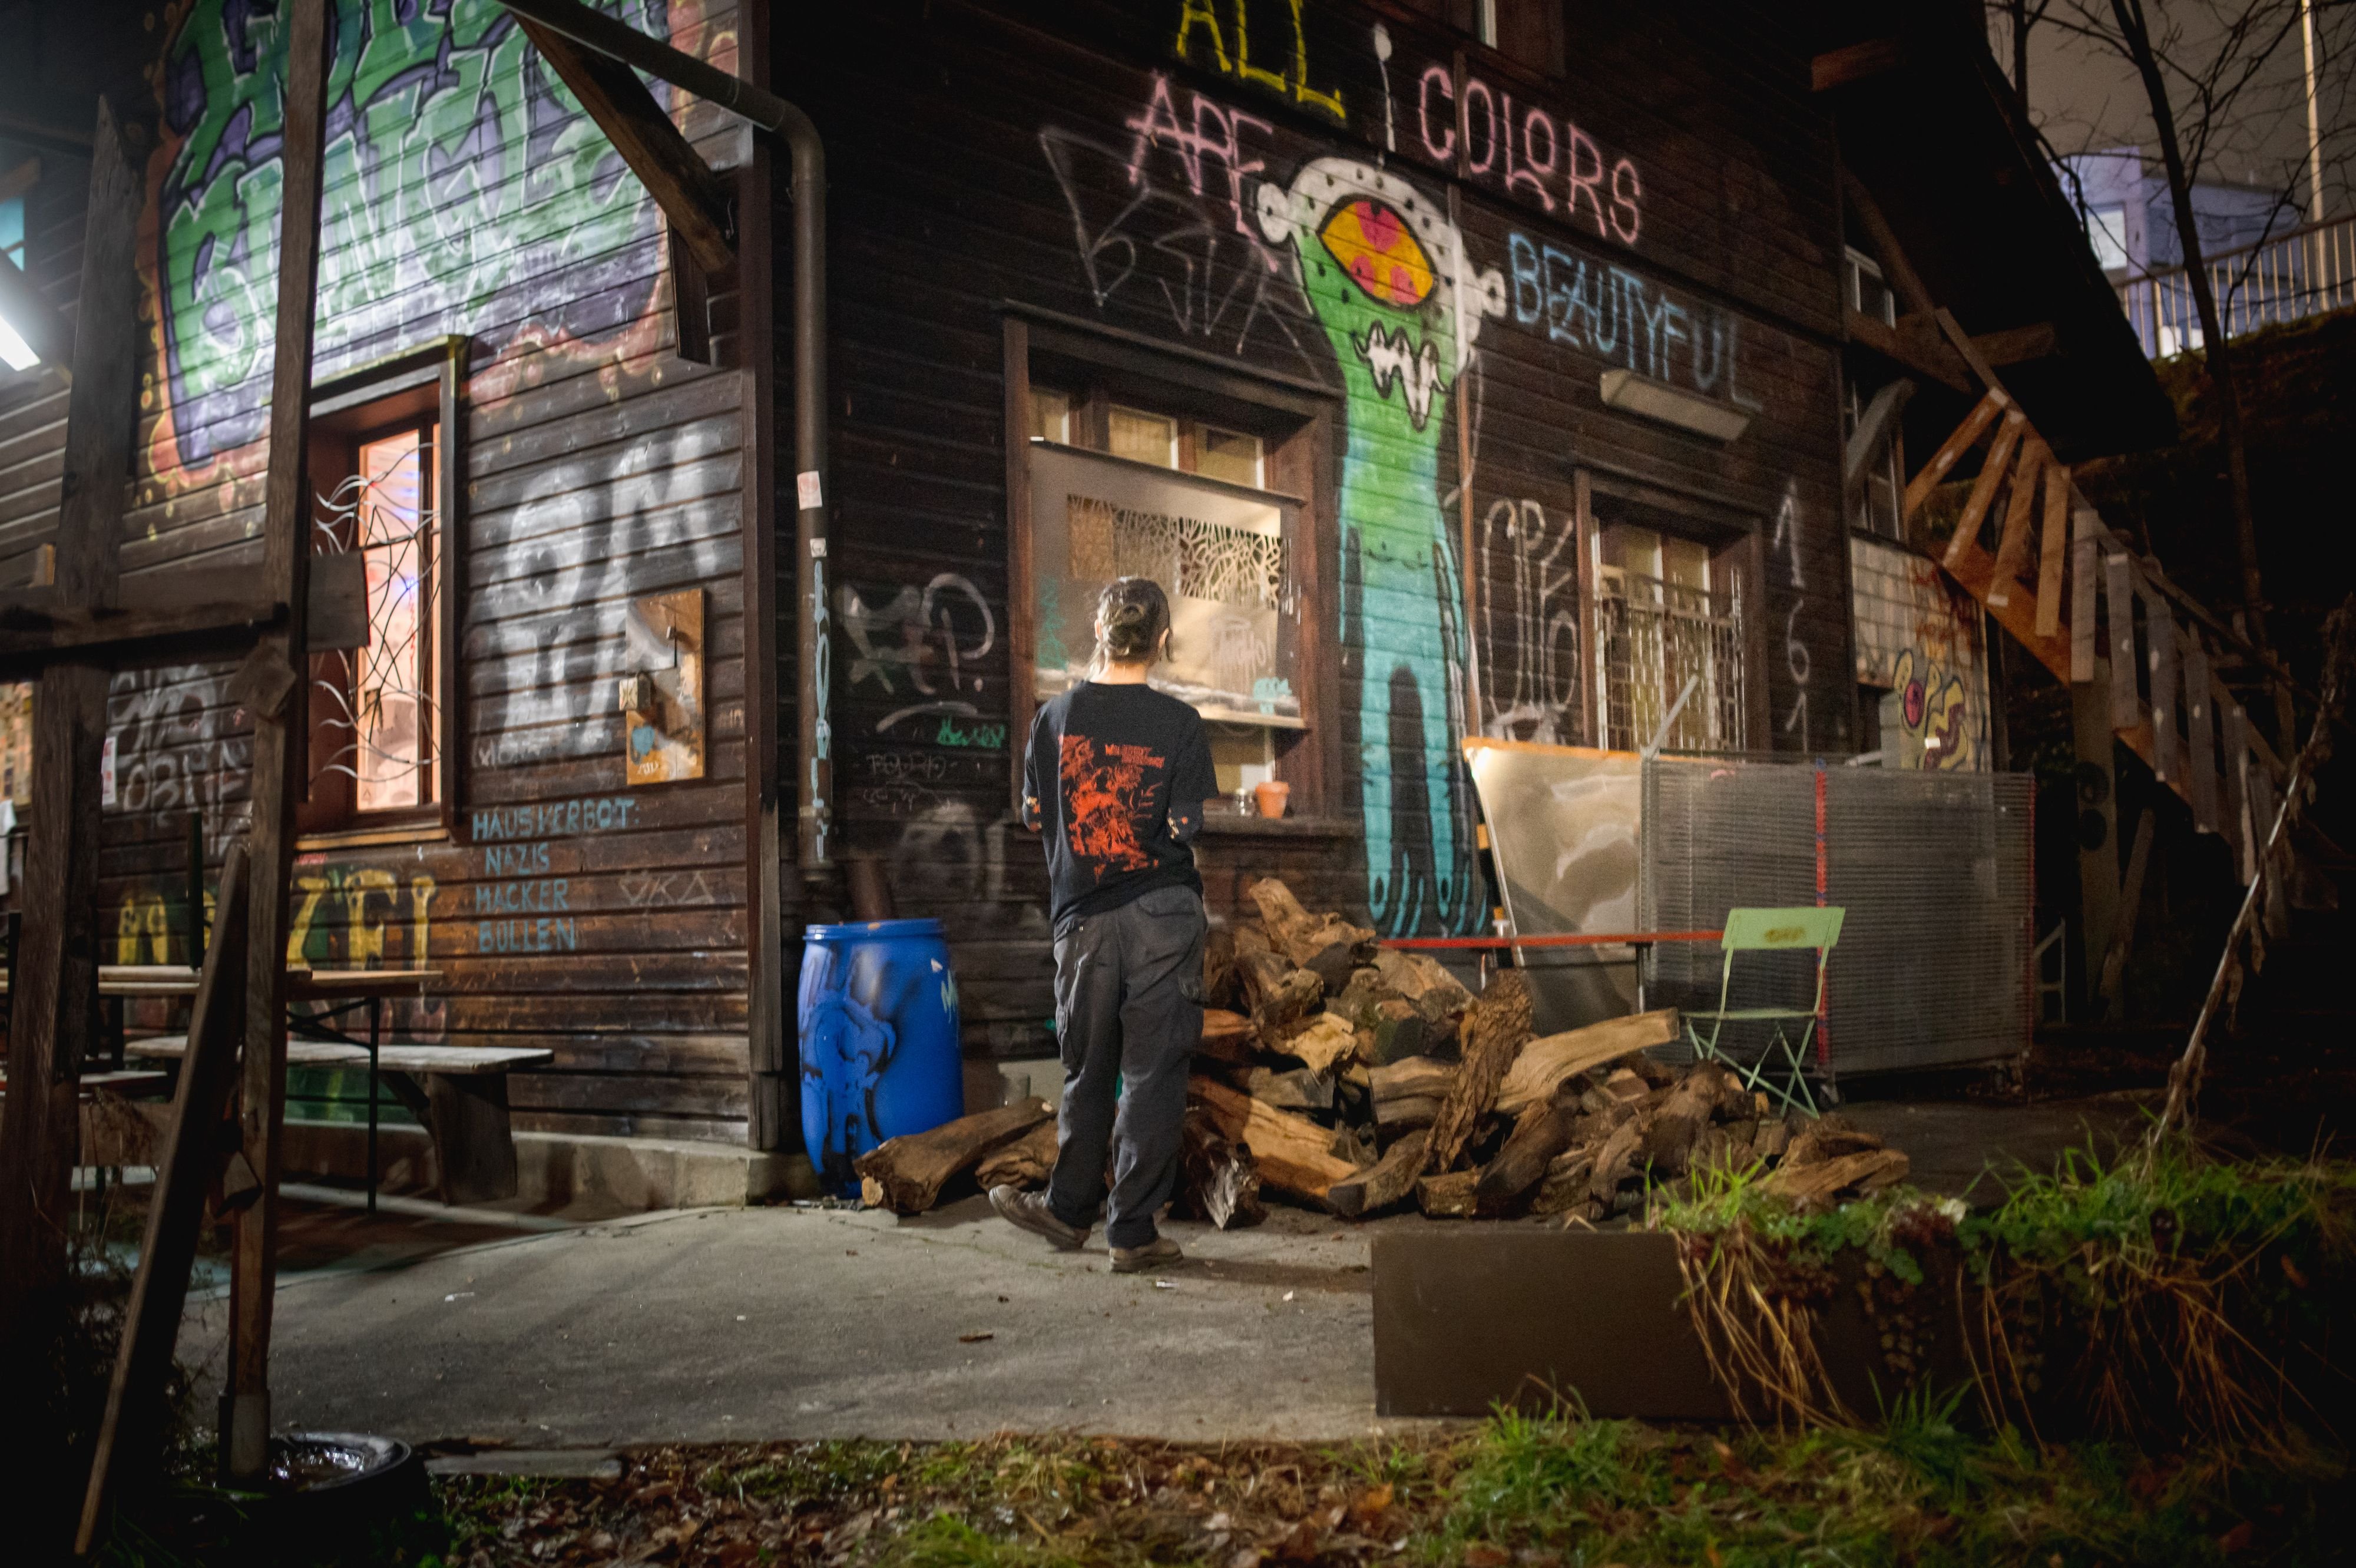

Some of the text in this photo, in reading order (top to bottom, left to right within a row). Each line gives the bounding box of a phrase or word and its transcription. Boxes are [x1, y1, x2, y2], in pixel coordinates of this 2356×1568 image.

[1125, 72, 1278, 272] ARE
[1177, 0, 1642, 245] ALL COLORS
[1509, 232, 1763, 411] BEAUTYFUL
[475, 878, 570, 913] MACKER
[485, 842, 550, 876] NAZIS
[478, 917, 575, 952] BULLEN
